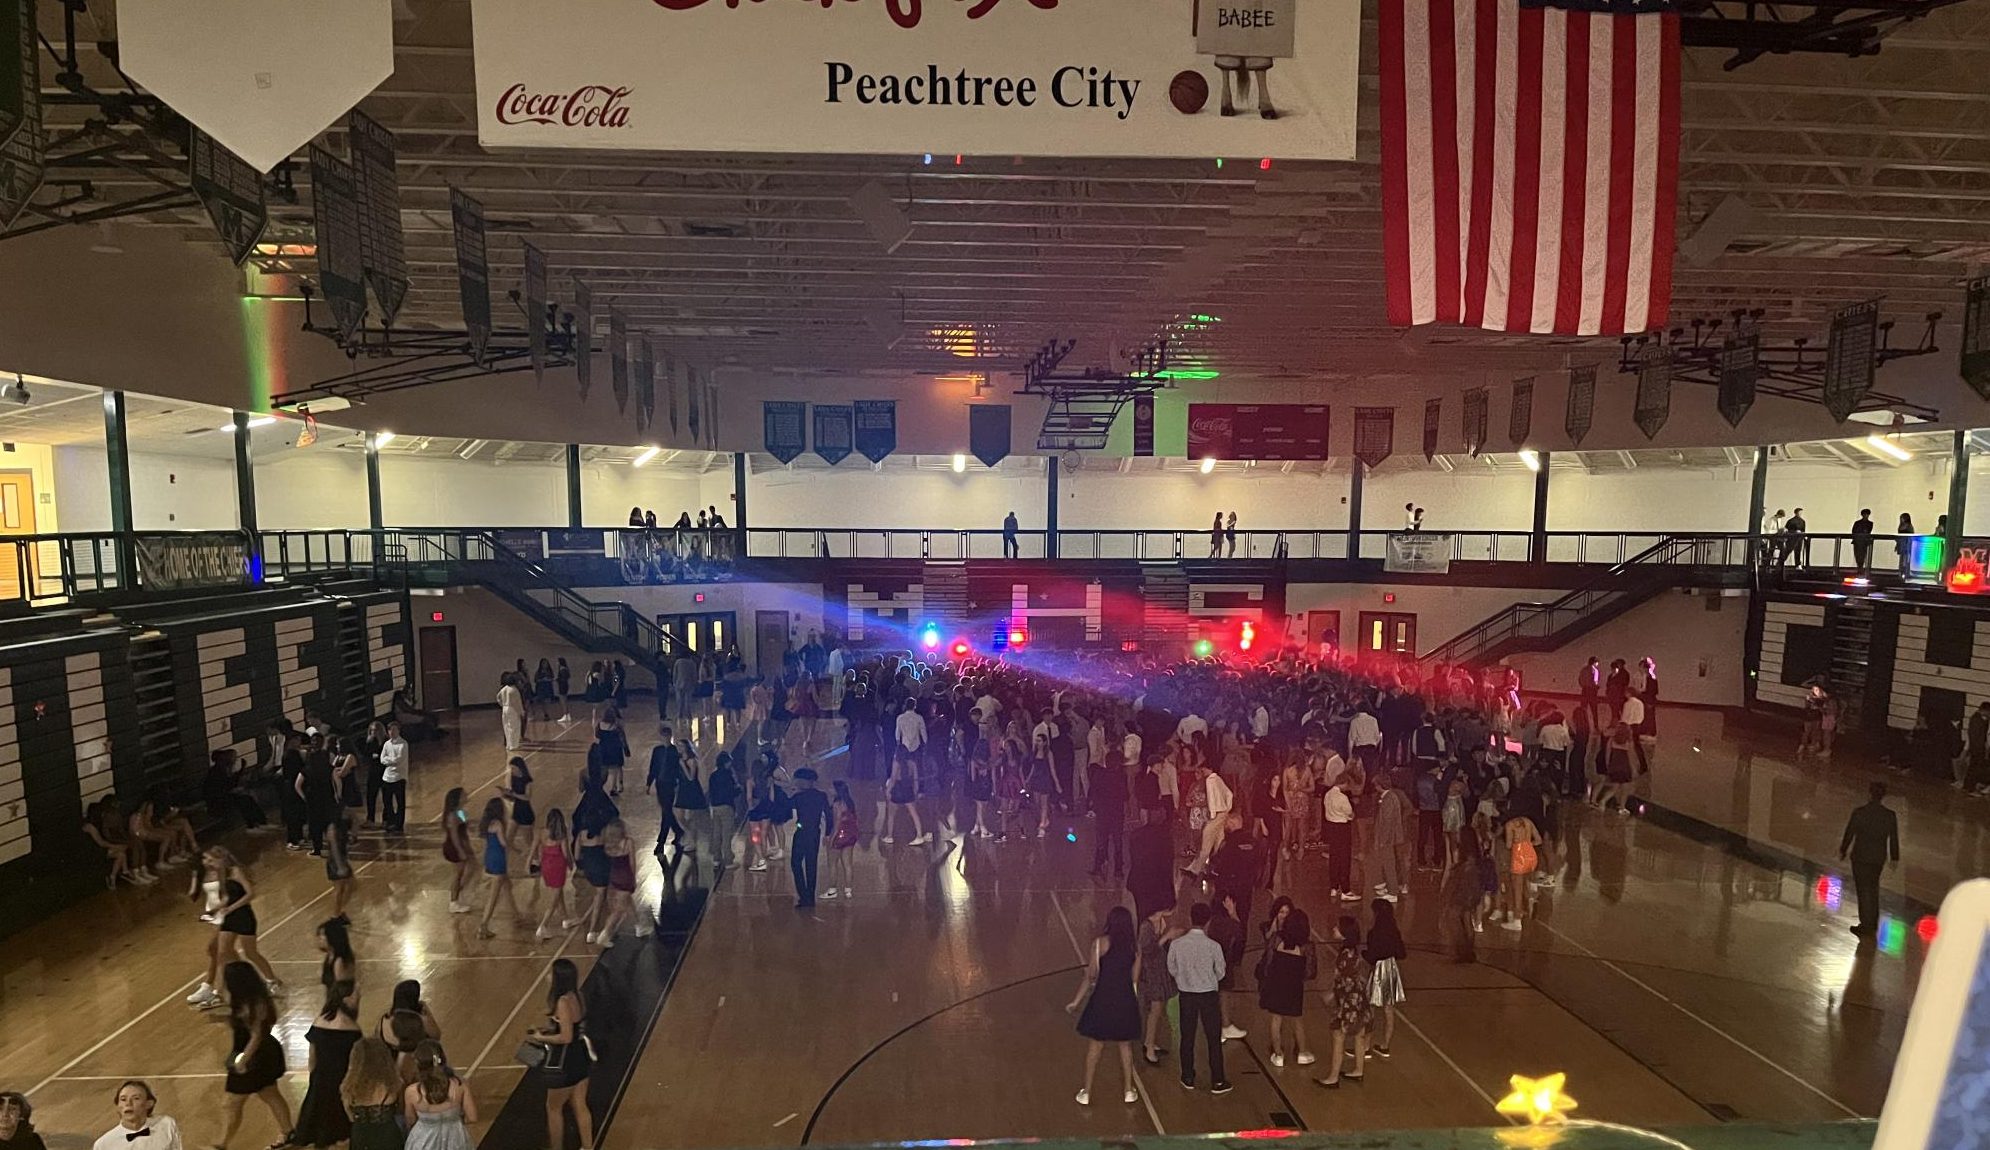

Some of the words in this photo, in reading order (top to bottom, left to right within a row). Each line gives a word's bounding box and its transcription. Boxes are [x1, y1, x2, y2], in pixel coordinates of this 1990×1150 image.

[1218, 8, 1276, 28] BABEE
[496, 83, 635, 128] Coca-Cola
[823, 62, 1037, 107] Peachtree
[1051, 66, 1141, 120] City
[164, 547, 192, 580] HOME
[191, 546, 203, 578] OF
[203, 546, 221, 577] THE
